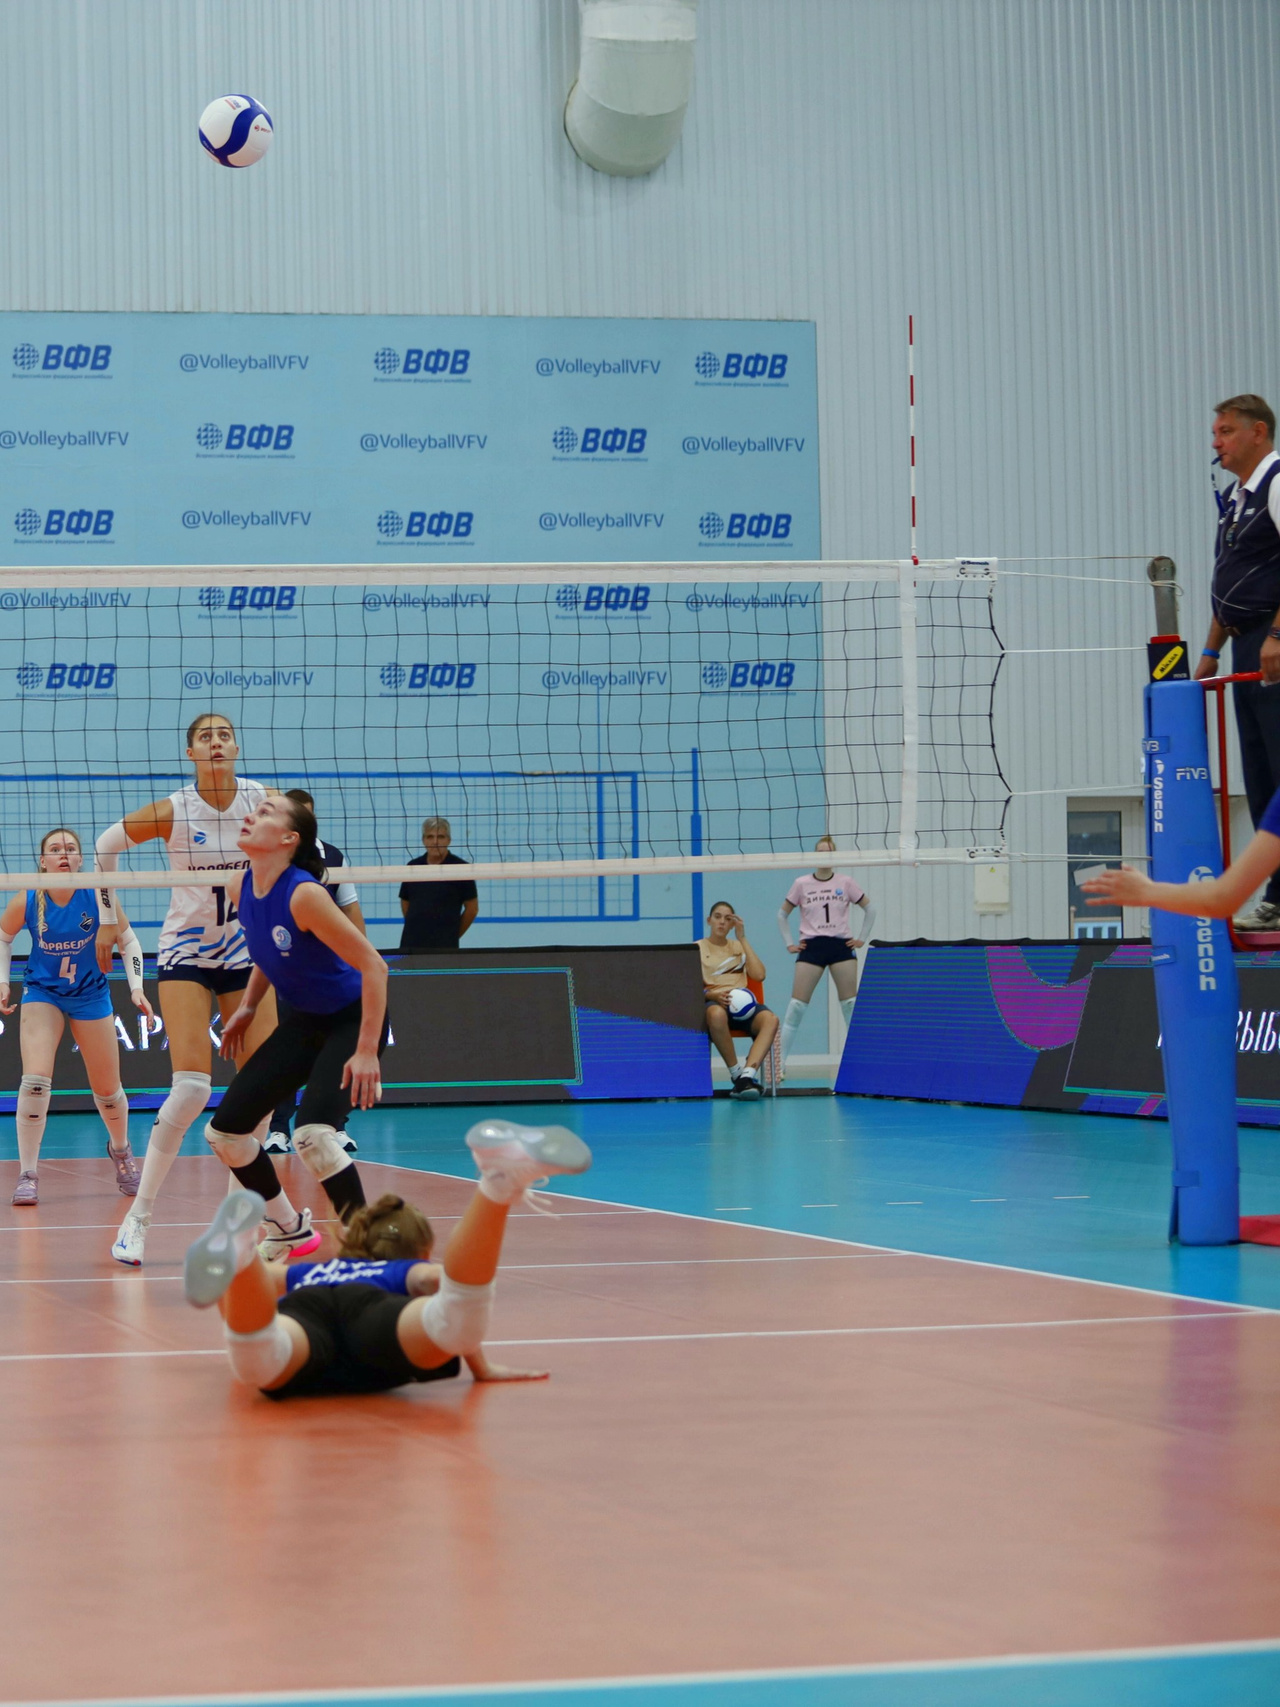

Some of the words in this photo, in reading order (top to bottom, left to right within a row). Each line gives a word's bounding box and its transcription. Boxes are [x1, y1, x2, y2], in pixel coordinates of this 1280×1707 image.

[42, 343, 112, 371] ВФВ
[180, 354, 309, 373] @VolleyballVFV
[403, 347, 471, 375] ВФВ
[536, 358, 661, 377] @VolleyballVFV
[722, 352, 789, 379] ВФВ
[226, 423, 295, 451] ВФВ
[360, 433, 487, 453] @VolleyballVFV
[581, 426, 648, 454] ВФВ
[682, 436, 805, 455] @VolleyballVFV
[44, 508, 115, 536] ВФВ
[182, 510, 311, 530] @VolleyballVFV
[406, 510, 475, 538] ВФВ
[539, 512, 664, 531] @VolleyballVFV
[726, 512, 793, 539] ВФВ
[0, 592, 131, 611] @VolleyballVFV
[228, 586, 297, 612] ВФВ
[363, 593, 490, 613] @VolleyballVFV
[584, 584, 651, 612] ВФВ
[686, 593, 809, 612] @VolleyballVFV
[46, 662, 117, 690] ВФВ
[184, 670, 313, 690] @VolleyballVFV
[409, 662, 478, 690] ВФВ
[542, 670, 667, 689] @VolleyballVFV
[729, 661, 796, 688] ВФВ
[1153, 777, 1164, 833] Senoh
[823, 903, 830, 923] 1
[59, 956, 77, 985] 4
